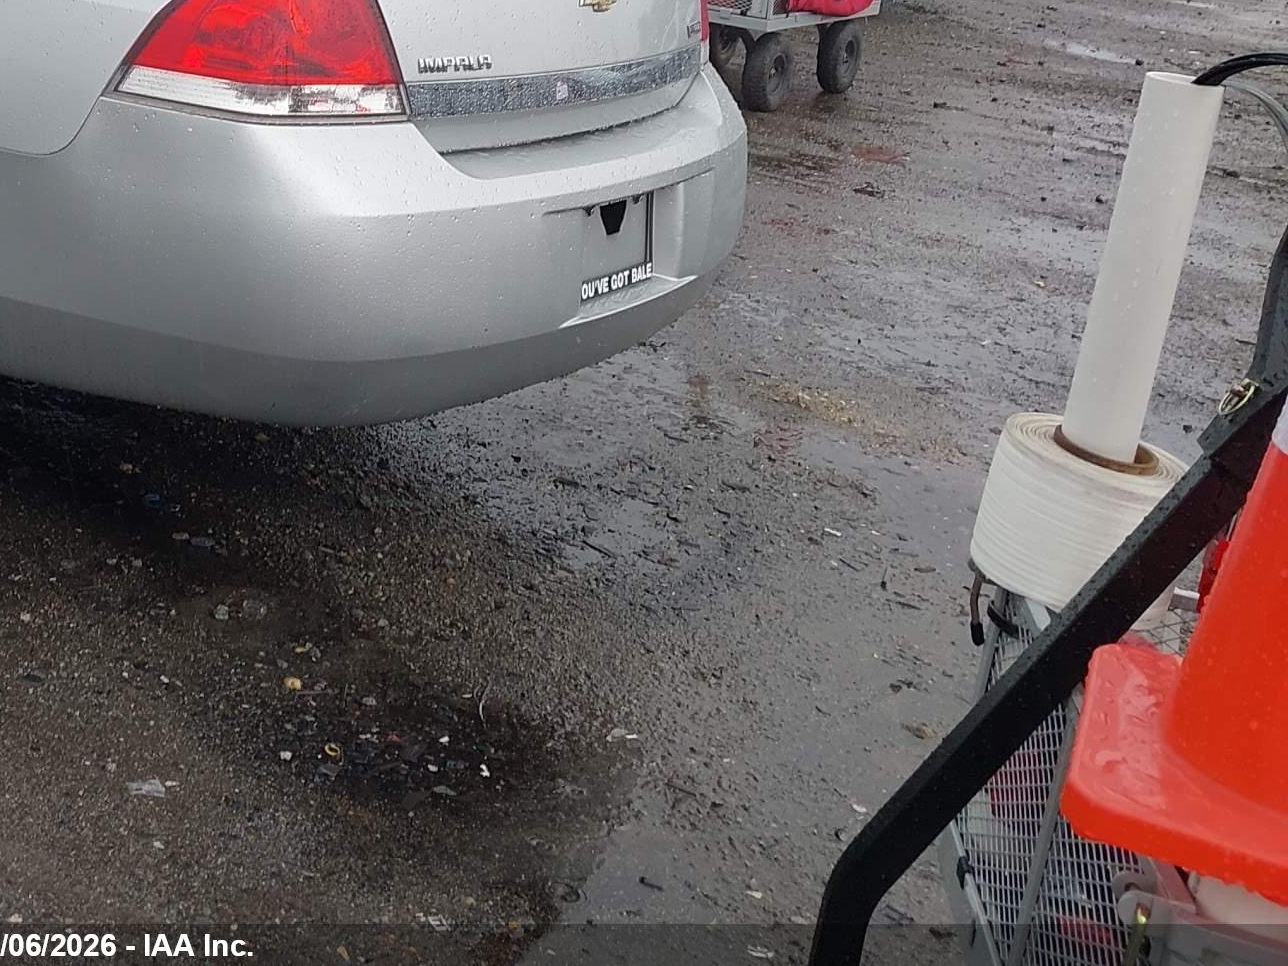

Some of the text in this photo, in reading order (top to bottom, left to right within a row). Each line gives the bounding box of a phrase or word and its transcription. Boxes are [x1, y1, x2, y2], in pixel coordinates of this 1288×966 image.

[416, 54, 493, 75] IMPALA
[581, 262, 653, 301] OU'VE GOT BALE
